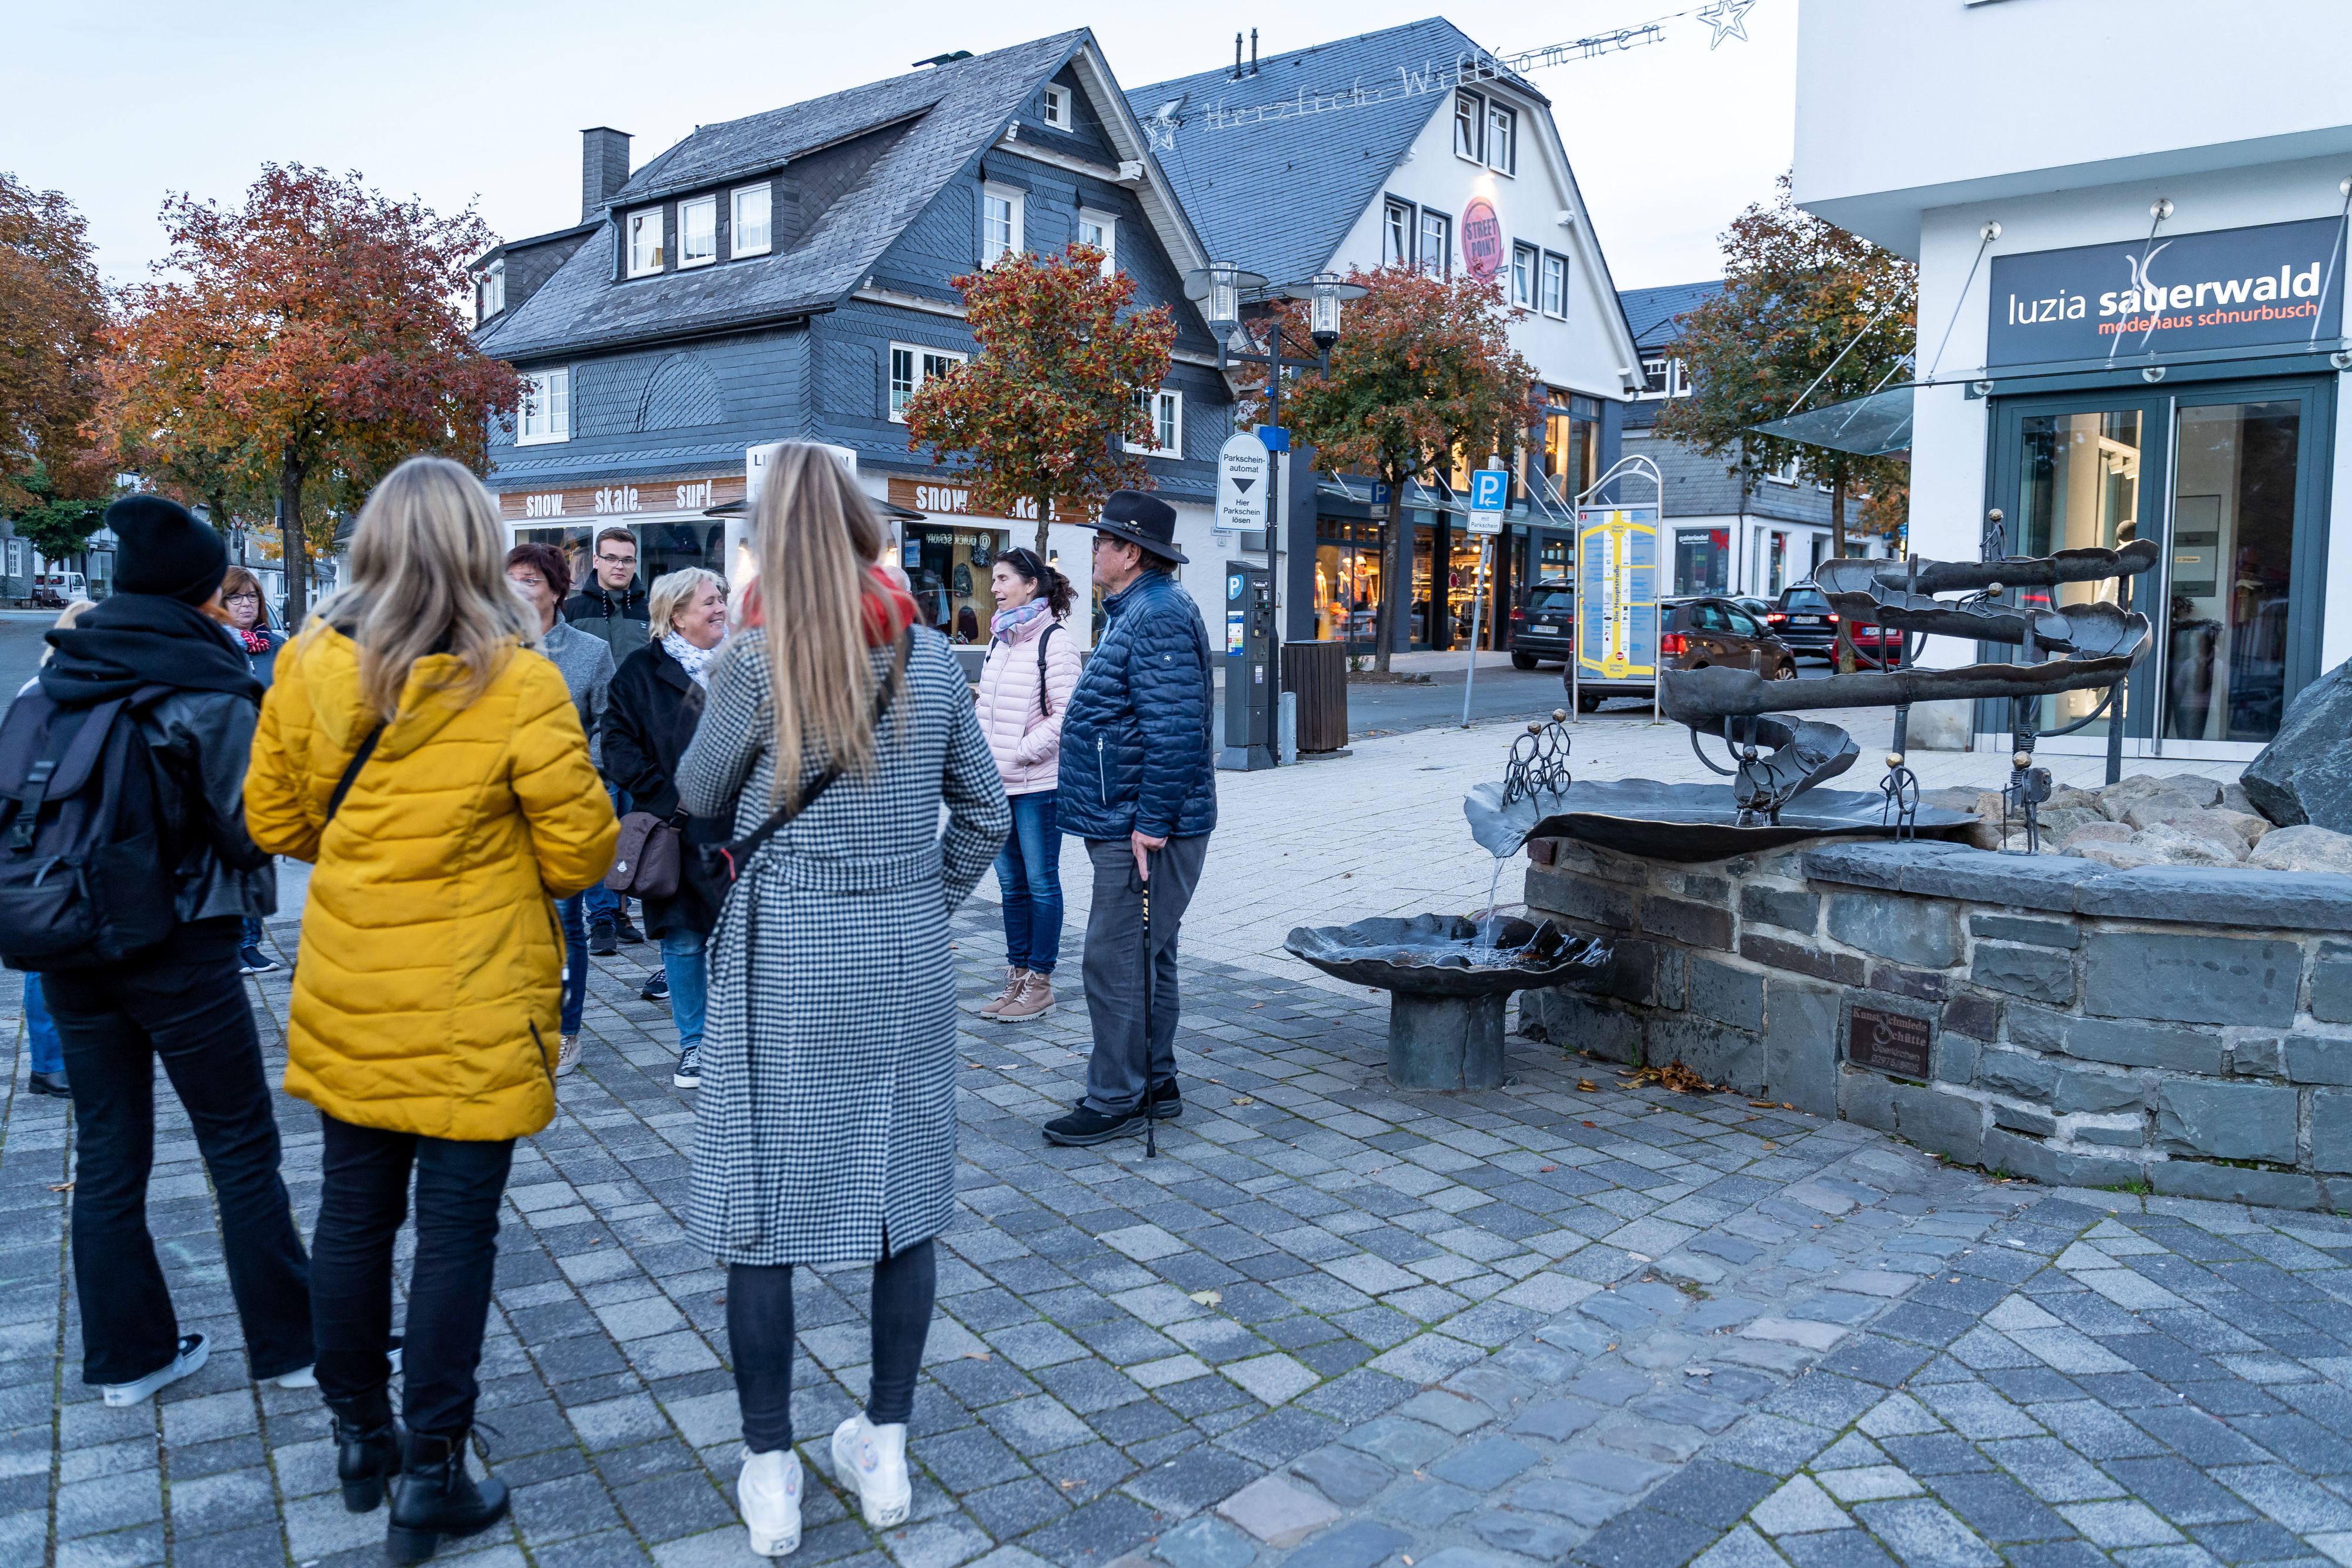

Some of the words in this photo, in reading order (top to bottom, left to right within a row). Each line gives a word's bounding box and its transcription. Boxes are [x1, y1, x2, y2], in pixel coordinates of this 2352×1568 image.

[1465, 218, 1496, 240] STREET
[1472, 238, 1495, 258] POINT
[2009, 289, 2086, 326] luzia
[2099, 262, 2321, 317] sauerwald
[2099, 314, 2193, 335] modehaus
[2198, 300, 2318, 327] schnurbusch
[1224, 454, 1265, 464] Parkschein-
[1230, 465, 1259, 473] automat
[595, 486, 642, 513] skate.
[676, 479, 716, 509] surf.
[1479, 476, 1499, 504] P
[526, 494, 565, 517] snow.
[1224, 507, 1261, 516] Parkschein
[1230, 577, 1240, 596] P
[1872, 1044, 1920, 1061] Oberkirchen
